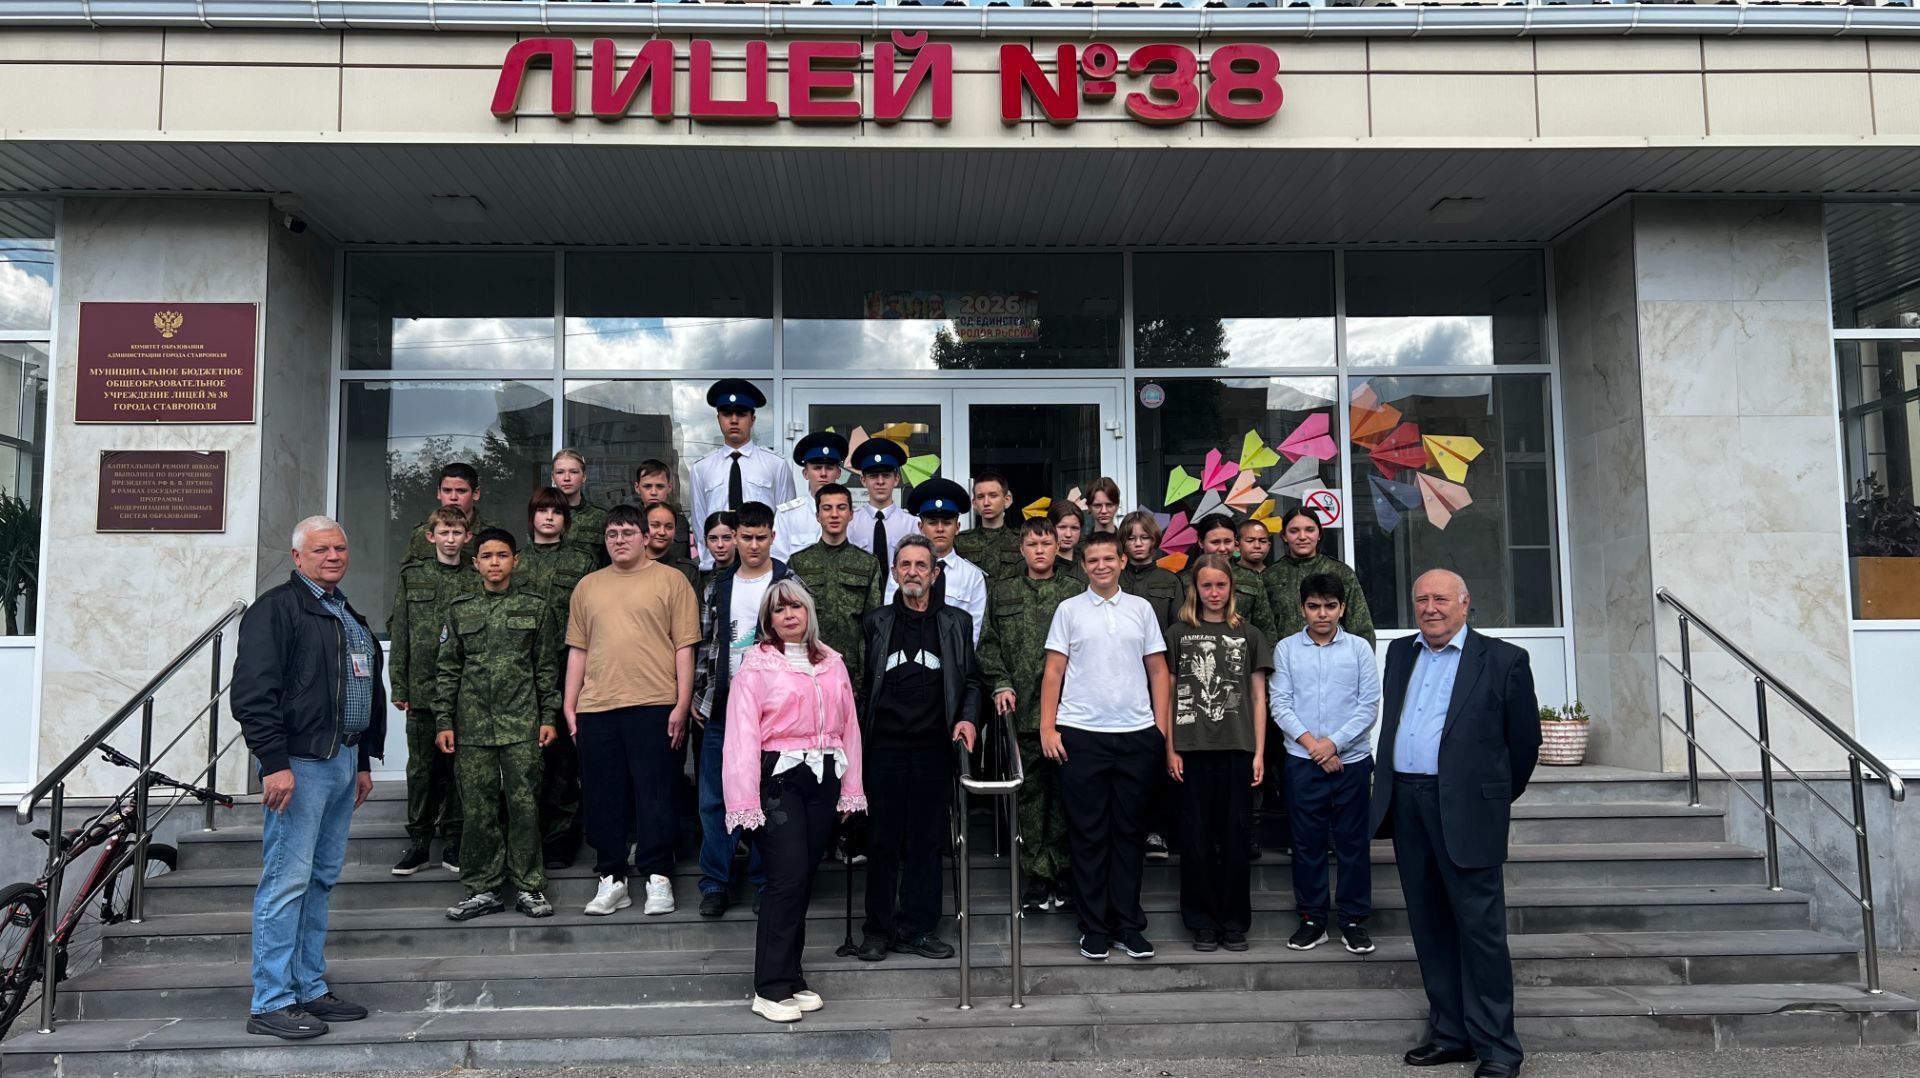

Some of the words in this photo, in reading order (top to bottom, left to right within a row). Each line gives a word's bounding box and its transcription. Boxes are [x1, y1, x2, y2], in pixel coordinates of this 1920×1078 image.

[491, 29, 954, 122] ЛИЦЕЙ
[960, 295, 1021, 314] 2026
[89, 368, 178, 377] МУНИЦИПАЛЬНОЕ
[181, 368, 244, 376] БЮДЖЕТНОЕ
[106, 380, 226, 388] ОБЩЕОБРАЗОВАТЕЛЬНОЕ
[104, 391, 170, 400] УЧРЕЖДЕНИЕ
[171, 390, 205, 400] ЛИЦЕЙ
[207, 391, 217, 399] №
[218, 391, 228, 399] 38
[113, 403, 151, 411] ГОРОДА
[153, 402, 217, 411] СТАВРОПОЛЯ
